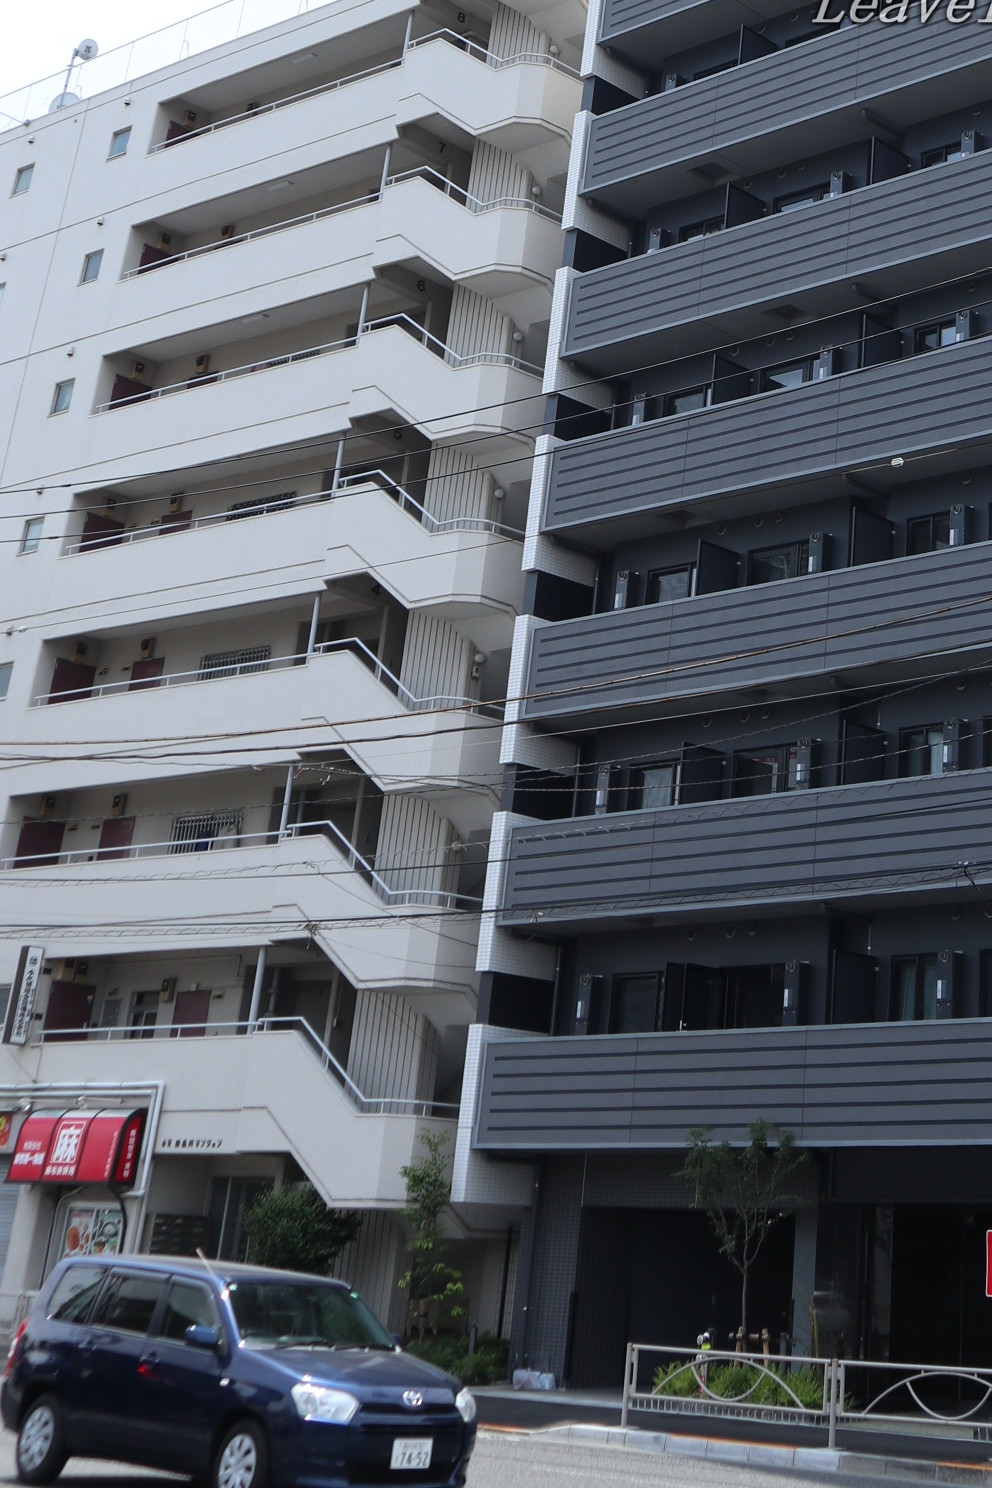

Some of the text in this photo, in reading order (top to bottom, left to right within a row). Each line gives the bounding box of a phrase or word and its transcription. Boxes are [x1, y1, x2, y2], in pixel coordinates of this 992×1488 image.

[457, 11, 466, 23] 8
[438, 141, 447, 153] 7
[417, 279, 426, 292] 6
